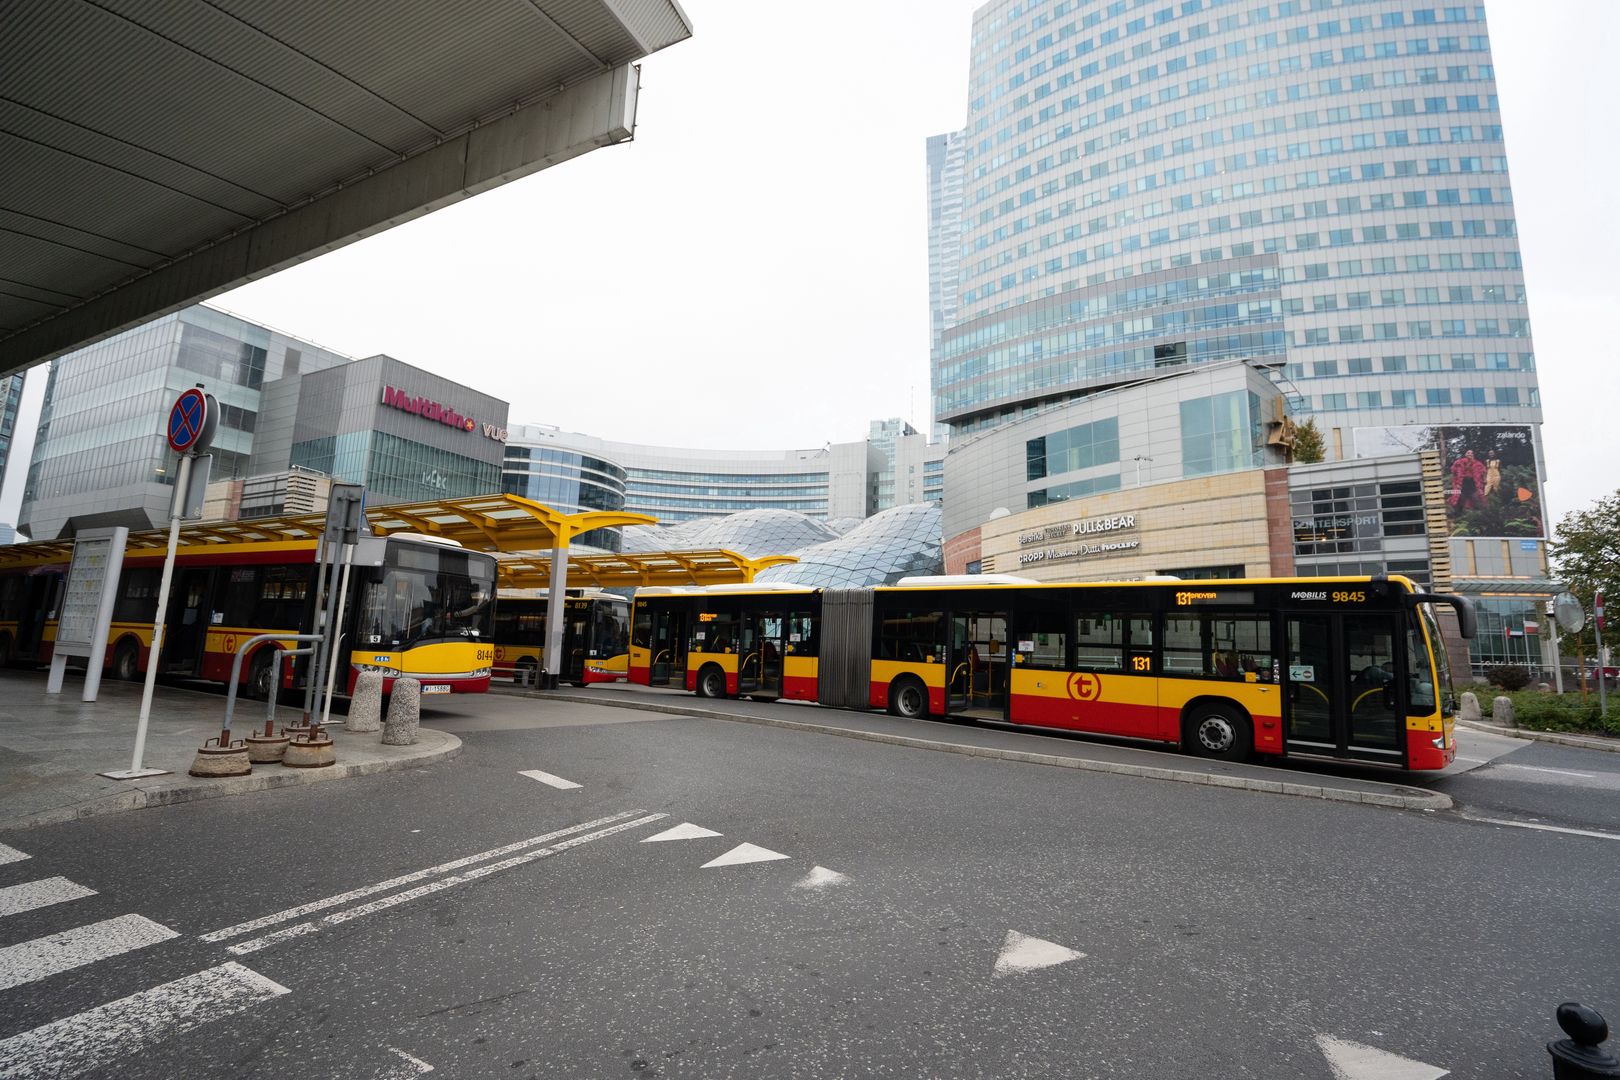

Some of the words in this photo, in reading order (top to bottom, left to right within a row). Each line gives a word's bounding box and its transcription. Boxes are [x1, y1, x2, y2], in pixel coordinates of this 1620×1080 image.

[382, 384, 475, 432] Multikino
[482, 422, 508, 442] vue
[1073, 515, 1135, 535] PULL&BEAR
[1306, 515, 1377, 530] INTERSPORT
[1101, 541, 1139, 551] house
[1018, 551, 1044, 564] CROPP
[1176, 592, 1191, 605] 131
[1291, 591, 1327, 600] MOBILIS
[1332, 591, 1366, 602] 9845
[476, 650, 493, 660] 8144
[1132, 656, 1151, 671] 131
